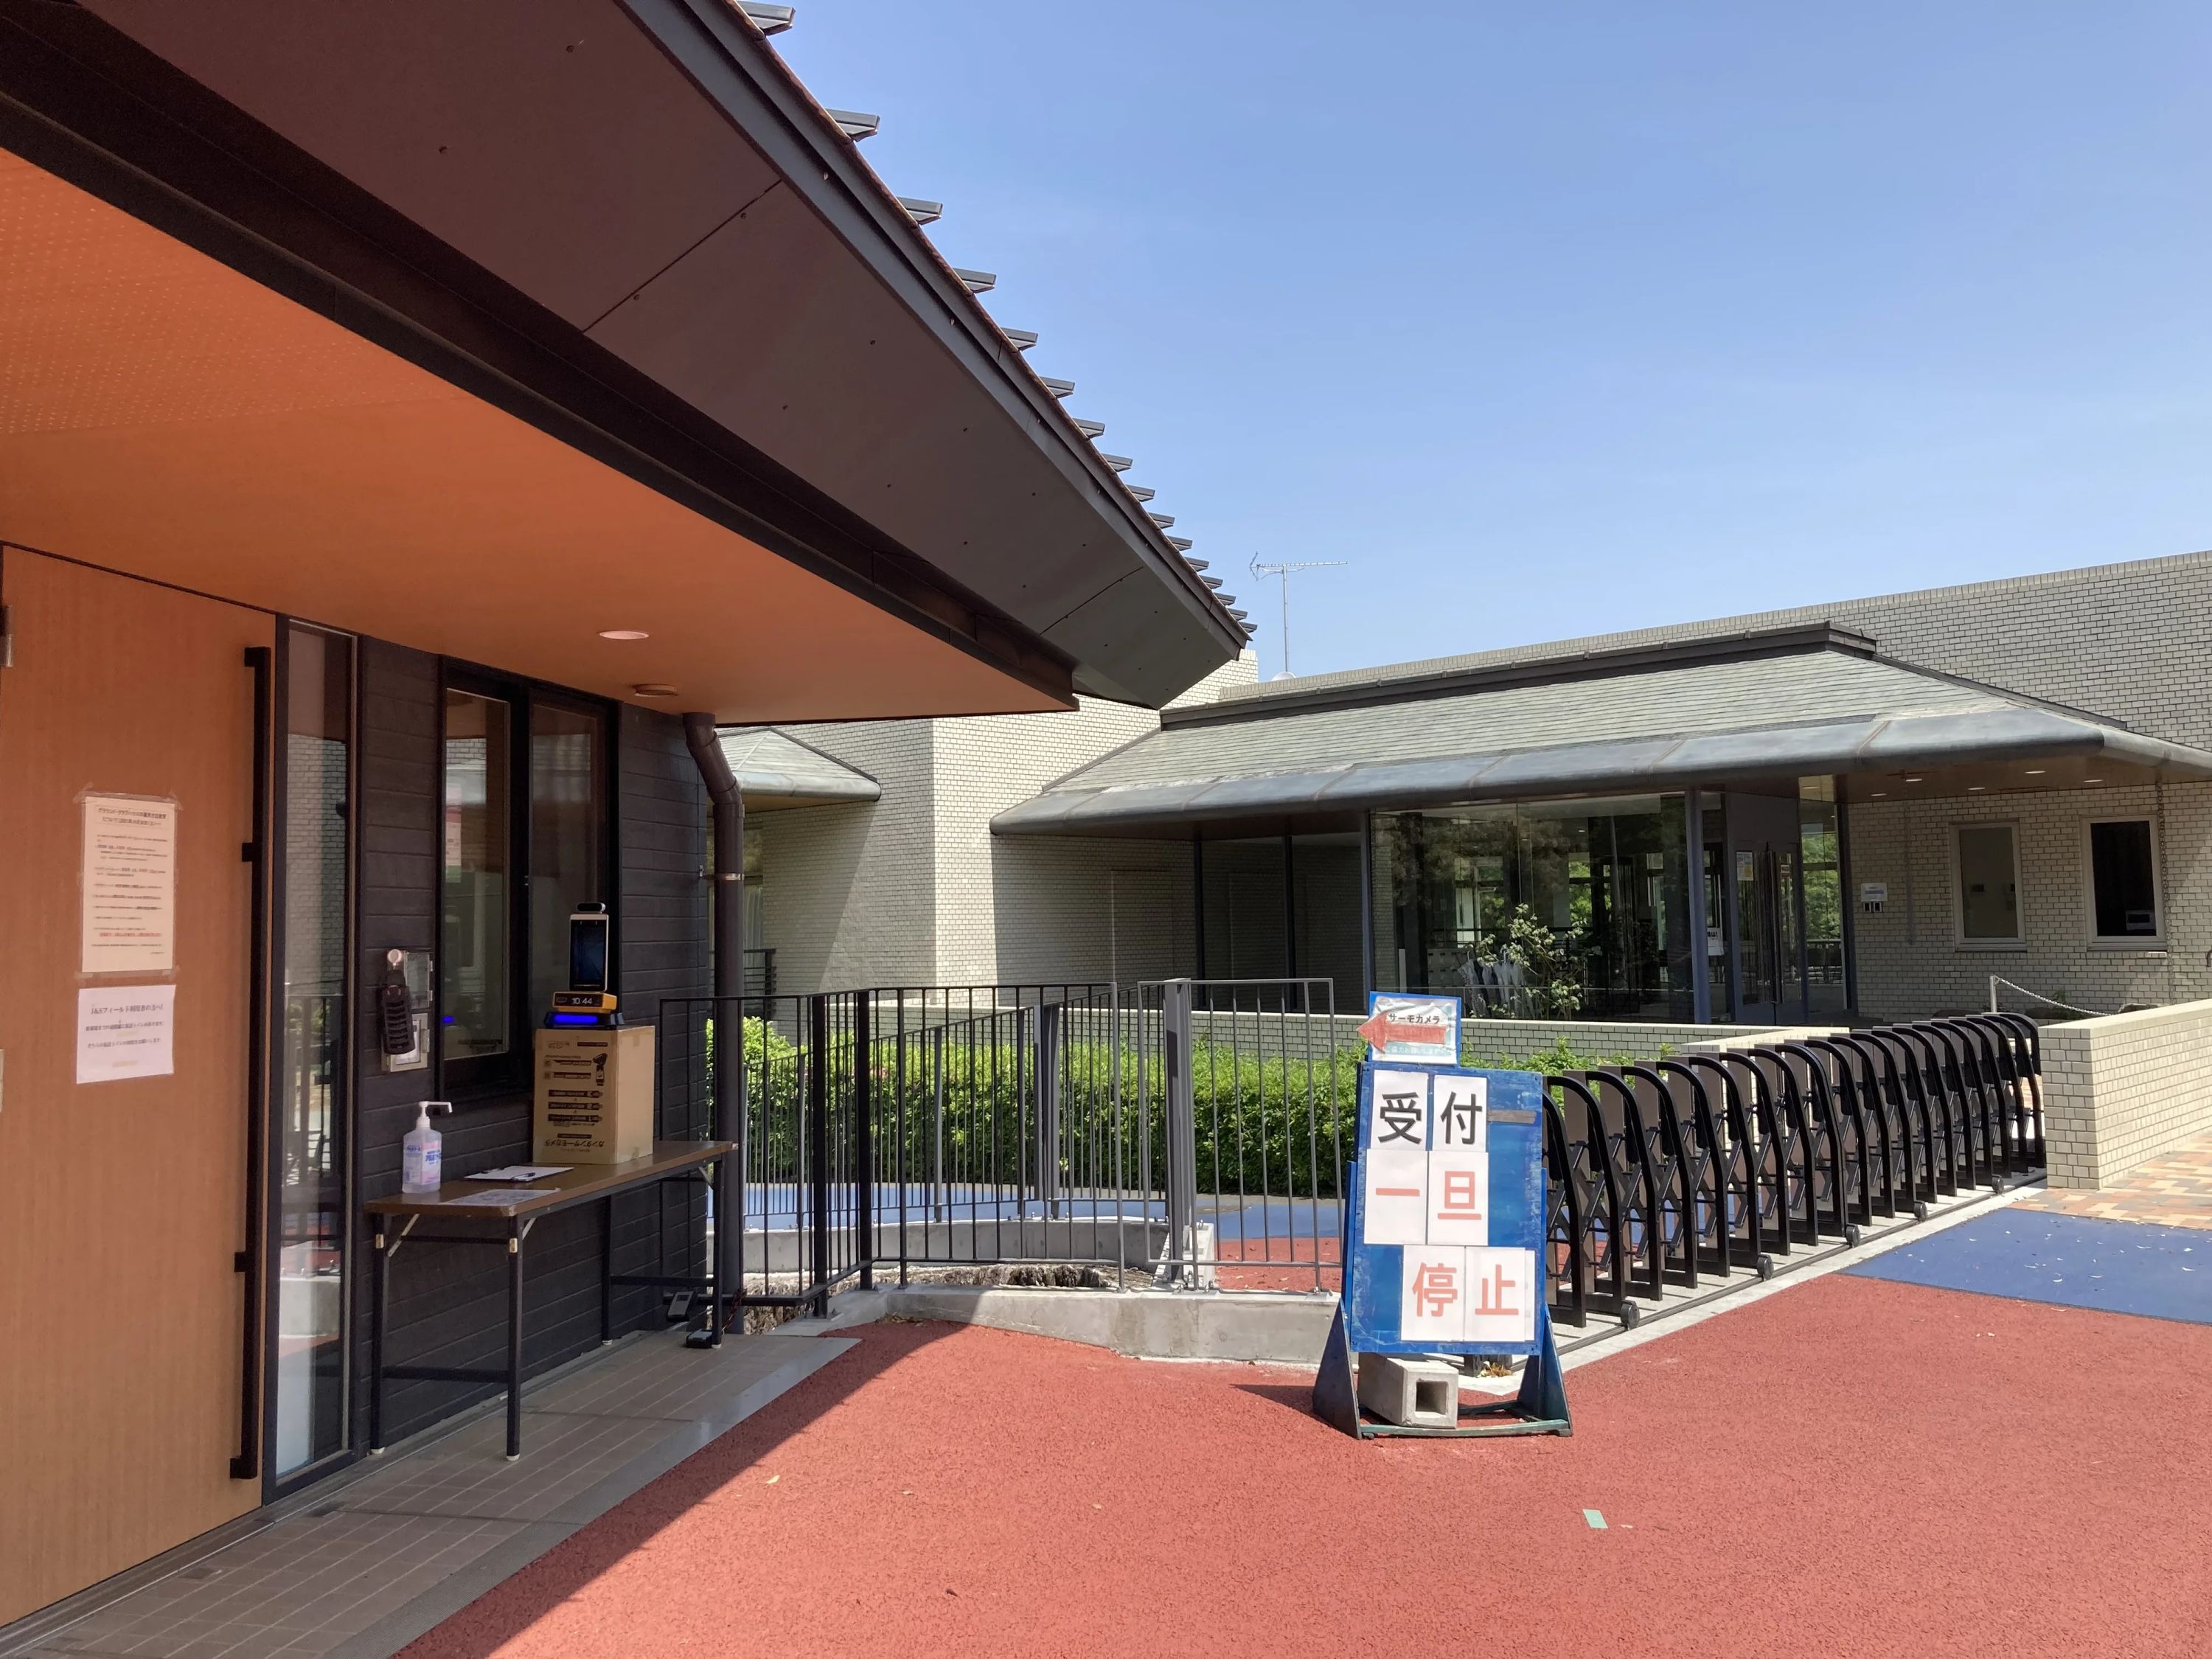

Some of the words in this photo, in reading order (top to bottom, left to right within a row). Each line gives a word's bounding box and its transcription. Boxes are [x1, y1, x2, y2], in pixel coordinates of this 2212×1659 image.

[1388, 1012, 1440, 1024] サーモカメラ
[1378, 1092, 1483, 1144] 受付
[1376, 1171, 1482, 1220] 一旦
[1412, 1262, 1519, 1318] 停止
